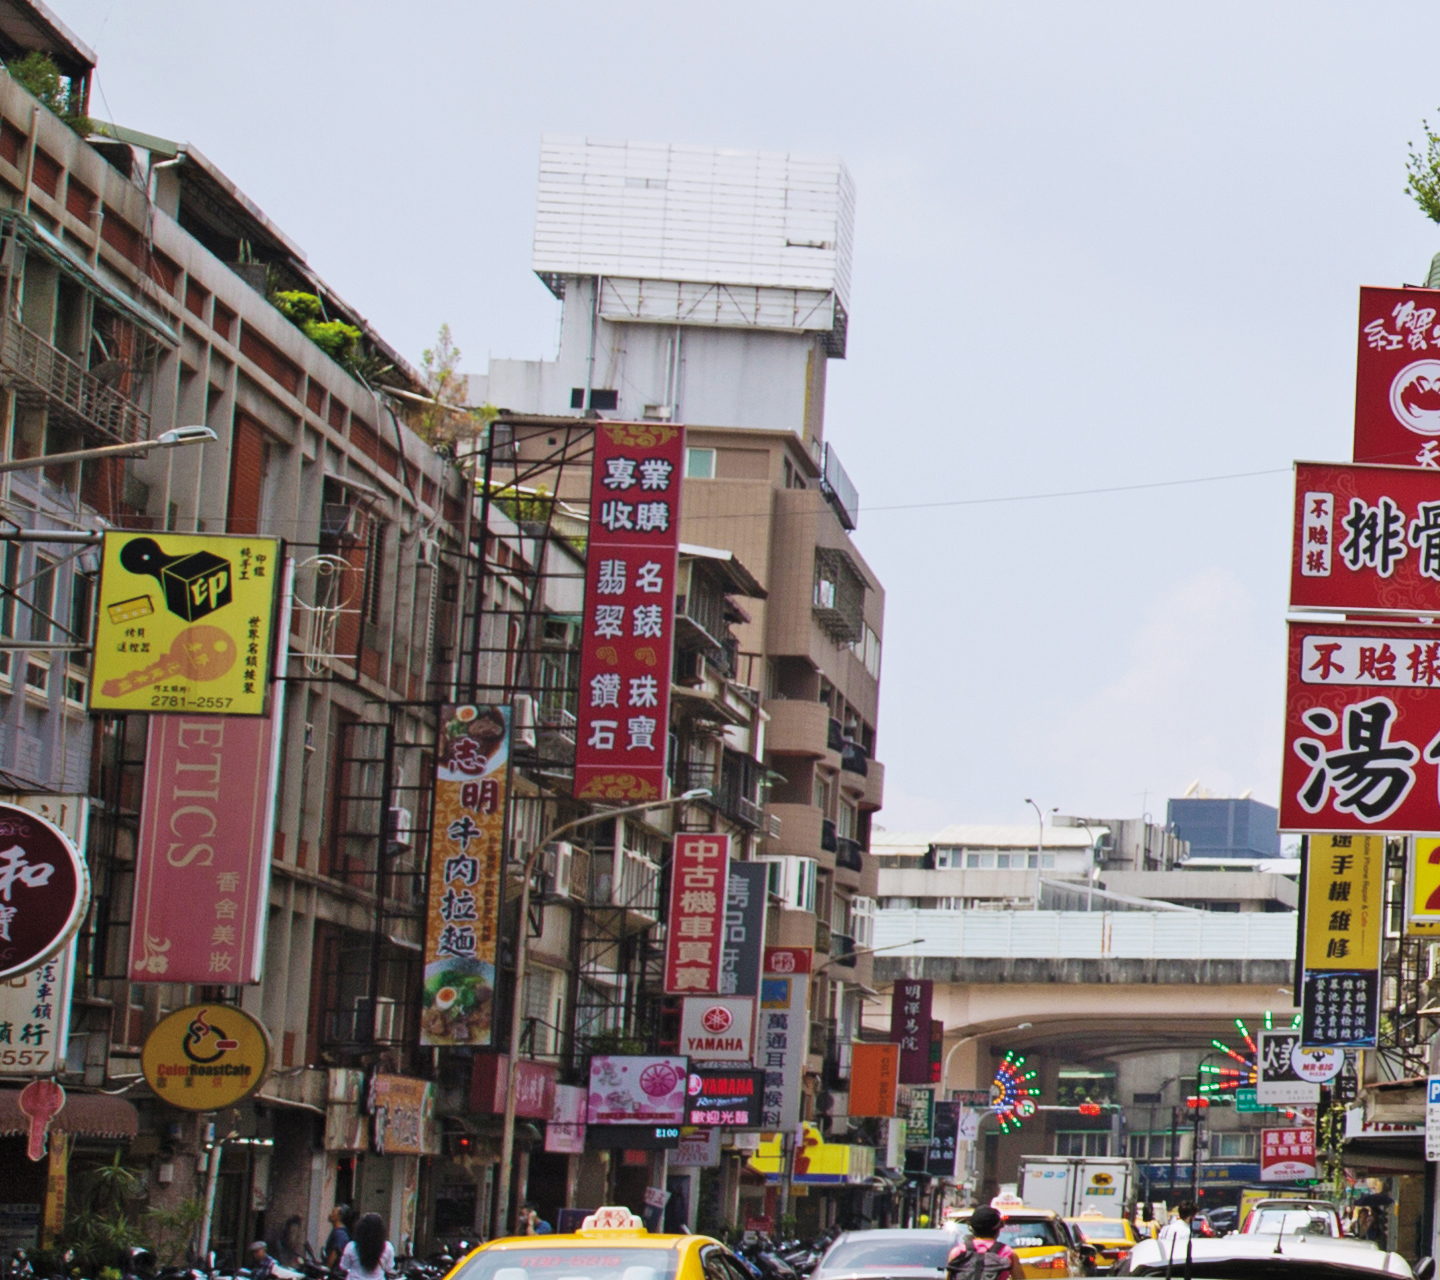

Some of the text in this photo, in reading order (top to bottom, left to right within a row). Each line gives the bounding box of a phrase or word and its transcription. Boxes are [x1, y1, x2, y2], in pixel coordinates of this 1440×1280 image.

[602, 457, 673, 490] 專業
[600, 500, 669, 532] 收購
[594, 559, 627, 640] 翡翠
[632, 560, 663, 639] 名錶
[151, 696, 233, 708] 2781-2557
[587, 673, 621, 751] 鑽石
[627, 674, 658, 751] 珠寶
[673, 839, 719, 990] 中古機車買賣
[687, 1037, 743, 1051] YAMAHA
[701, 1078, 754, 1095] YAMAHA
[593, 1219, 634, 1228] TAXI
